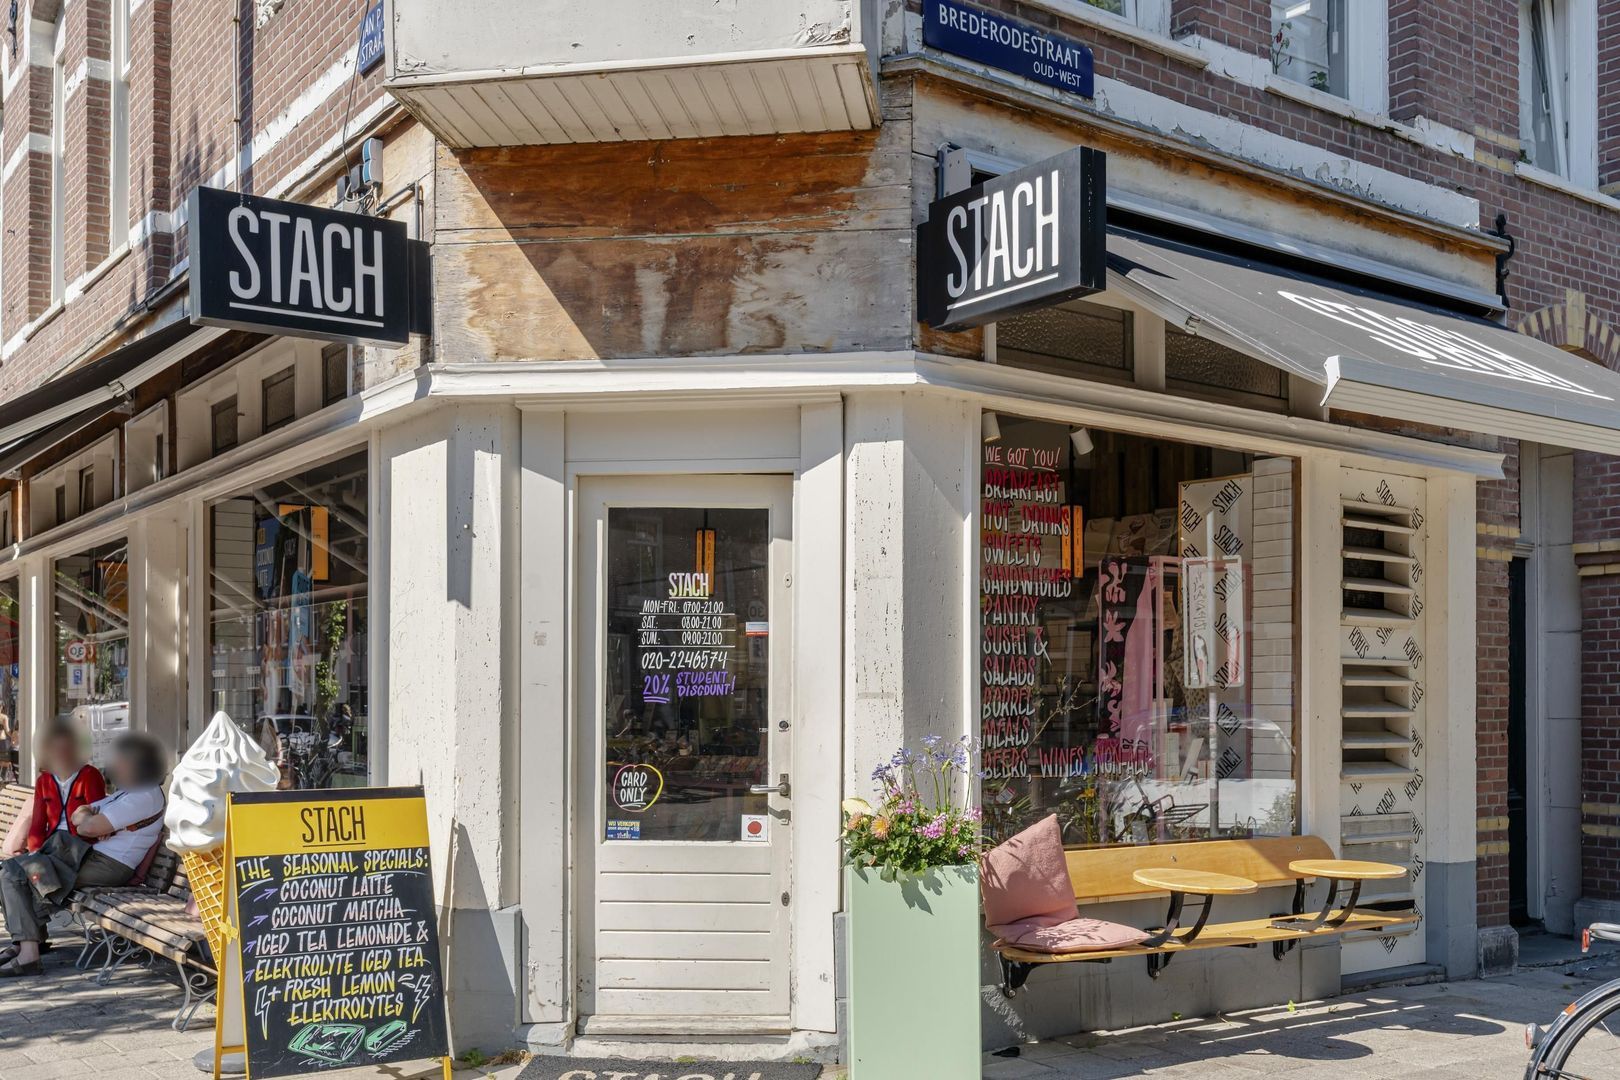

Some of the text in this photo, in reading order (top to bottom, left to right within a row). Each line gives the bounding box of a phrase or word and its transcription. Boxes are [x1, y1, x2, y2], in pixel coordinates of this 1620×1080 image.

[361, 29, 384, 64] STRAA
[939, 4, 1081, 69] BREDERODESTRAAT
[1033, 61, 1081, 87] OUD-WEST
[947, 169, 1059, 298] STACH
[228, 206, 384, 317] STACH
[985, 446, 1060, 468] WE GOT YOU!
[985, 468, 1060, 502] BREAKFAST
[1212, 480, 1243, 513] STACH
[1377, 480, 1396, 506] STACH
[983, 500, 1070, 535] HOT DRINKS
[984, 533, 1041, 566] SWEETS
[1213, 525, 1243, 555] STACH
[669, 572, 709, 596] STACH
[983, 565, 1071, 598] SANDWICHES
[983, 595, 1039, 626] PANTRY
[983, 625, 1051, 665] SUSHI &
[1348, 626, 1369, 659] STACH
[1403, 637, 1423, 669] STACH
[642, 650, 728, 669] 020-2246574
[983, 655, 1035, 686] SALADS
[643, 671, 728, 695] 20% STUDENT
[677, 676, 736, 697] DISCOUNT!
[1412, 682, 1424, 709] STAC
[982, 686, 1035, 719] BORREL
[982, 715, 1030, 749] MEALS
[620, 787, 647, 802] ONLY
[621, 772, 647, 786] CARD
[1404, 769, 1423, 801] STACH
[1376, 788, 1396, 814] STACH
[301, 806, 366, 843] STACH
[236, 848, 428, 882] THE SEASONAL SPECIALS:
[280, 874, 393, 901] COCONUT LATTE
[271, 898, 414, 927] COCONUT MATCHA
[255, 920, 428, 955] ICED TEA LEMONADE &
[255, 946, 429, 982] ELEKTROLYTE ICED TEA
[284, 978, 331, 1002] FRESH
[342, 971, 395, 997] LEMON
[287, 993, 404, 1026] ELEKTROLYTES
